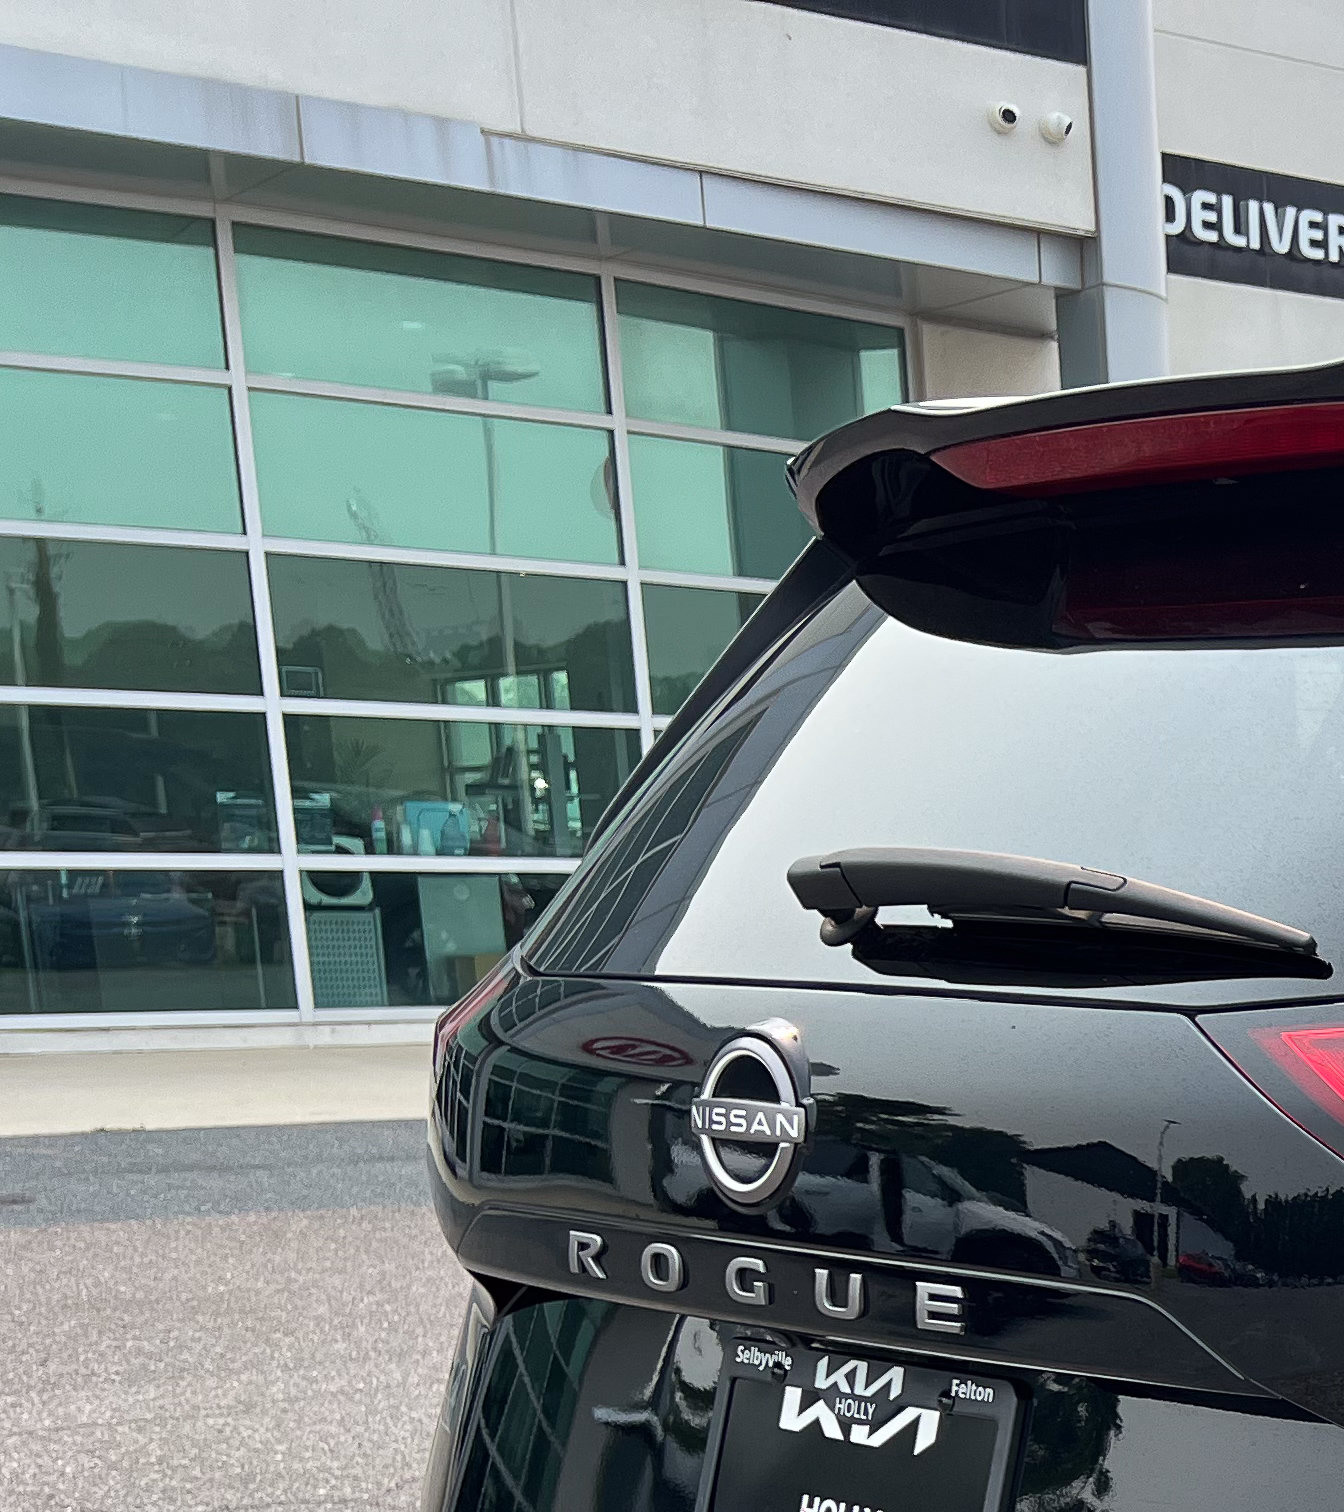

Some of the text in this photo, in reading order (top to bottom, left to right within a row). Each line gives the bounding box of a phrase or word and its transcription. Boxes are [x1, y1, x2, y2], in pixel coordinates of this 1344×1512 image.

[692, 1105, 799, 1138] NISSAN
[568, 1230, 966, 1335] ROGUE
[735, 1345, 793, 1371] Selbyville
[814, 1355, 905, 1400] KIA
[950, 1379, 994, 1403] Felton
[835, 1398, 877, 1421] HOLLY
